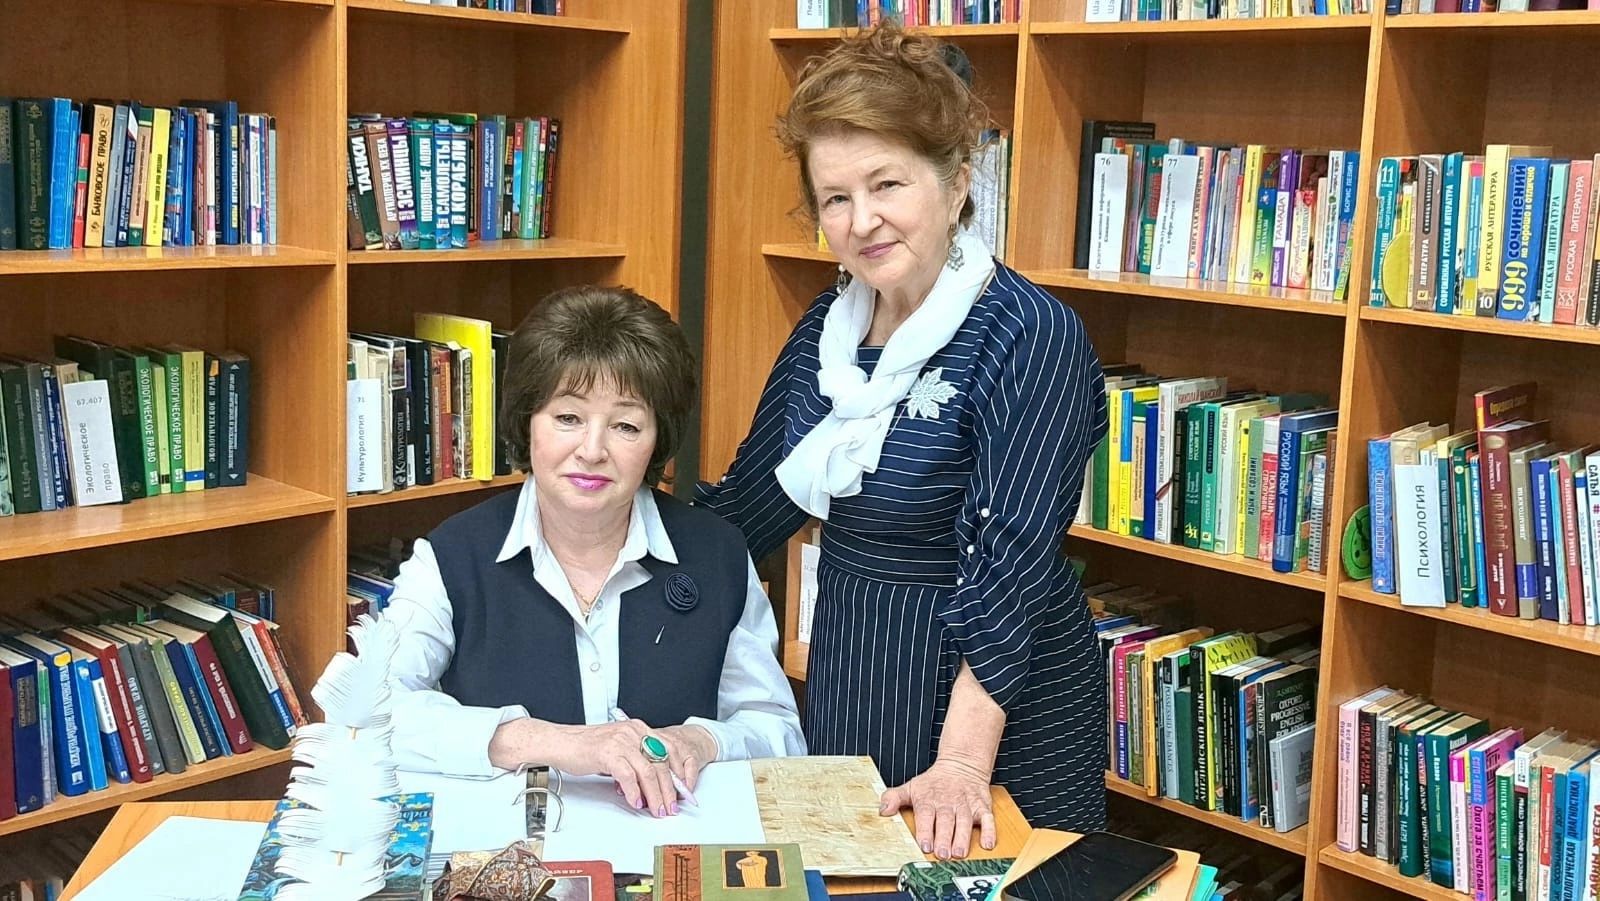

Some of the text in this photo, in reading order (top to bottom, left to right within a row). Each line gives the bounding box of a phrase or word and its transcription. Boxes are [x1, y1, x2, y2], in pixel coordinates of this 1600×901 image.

[351, 137, 373, 194] ТАНКИ
[376, 138, 388, 158] ВЕКА
[1101, 158, 1111, 166] 76
[91, 130, 108, 216] БАНКОВСКОЕ ПРАВО
[391, 135, 415, 208] ЭСМИНЦЫ
[419, 138, 433, 222] ПОДВОДНЫЕ ЛОДКИ
[436, 140, 450, 215] САМОЛЕТЫ
[451, 140, 467, 212] КОРАБЛИ
[1346, 162, 1354, 186] ЛЕВИН
[1382, 166, 1394, 182] 11
[1525, 166, 1536, 203] отлично
[381, 172, 397, 222] АРТИЛЛЕРИЯ
[1274, 196, 1286, 241] ТАМАДА
[1344, 188, 1352, 212] БОРИС
[1484, 172, 1498, 272] РУССКАЯ ЛИТЕРАТУРА
[1501, 166, 1528, 311] 999 сочинений
[1522, 212, 1532, 247] хорошо
[1564, 176, 1584, 282] РУССКАЯ ЛИТЕРАТУРА
[1420, 239, 1430, 286] ЛИТЕРАТУРА
[1440, 184, 1454, 307] СОВРЕМЕННАЯ РУССКАЯ ЛИТЕРАТУРА
[1521, 248, 1528, 258] на
[1544, 196, 1560, 300] РУССКАЯ ЛИТЕРАТУРА
[1480, 296, 1492, 309] 10
[34, 388, 42, 412] РОССИИ
[140, 368, 157, 462] ЭКОЛОГИЧЕСКОЕ ПРАВО
[170, 366, 182, 460] ЭКОЛОГИЧЕСКОЕ ПРАВО
[208, 401, 216, 462] ЭКОЛОГИЧЕСКОЕ
[358, 414, 366, 482] Культурология
[80, 422, 96, 494] Экологическое
[102, 462, 112, 490] право
[1249, 457, 1258, 488] СОЗНАНИЕ
[1278, 432, 1292, 496] РУССКИЙ ЯЗЫК
[1588, 464, 1600, 496] САТЬЯ
[1248, 498, 1256, 515] ЯЗЫК
[1268, 471, 1276, 512] ПОЛНЫЙ
[1312, 474, 1325, 506] СЛОВАРЬ
[1414, 484, 1430, 578] Психология
[128, 677, 140, 702] ПРАВО
[1166, 686, 1174, 730] POSSESSED
[1278, 694, 1303, 709] OXFORD
[136, 704, 152, 741] АГРАРНОЕ
[1270, 702, 1311, 722] PROGRESSIVE
[1280, 714, 1304, 730] ENGLISH
[1166, 742, 1174, 772] DANCES
[1198, 726, 1206, 802] АНГЛИЙСКИЙ
[1500, 810, 1507, 820] ДО
[1500, 822, 1508, 849] ЖИЗНЬ
[1400, 820, 1408, 864] Эрик БЕРН
[1474, 806, 1484, 891] Охота за счастьем
[1554, 832, 1562, 884] ОСОЗНАННЫЙ
[1562, 780, 1579, 901] ОЛОГИЧЕСКАЯ ДИАГНОСТИКА
[1589, 804, 1600, 898] ТАЙНЫ ЖЕСТА
